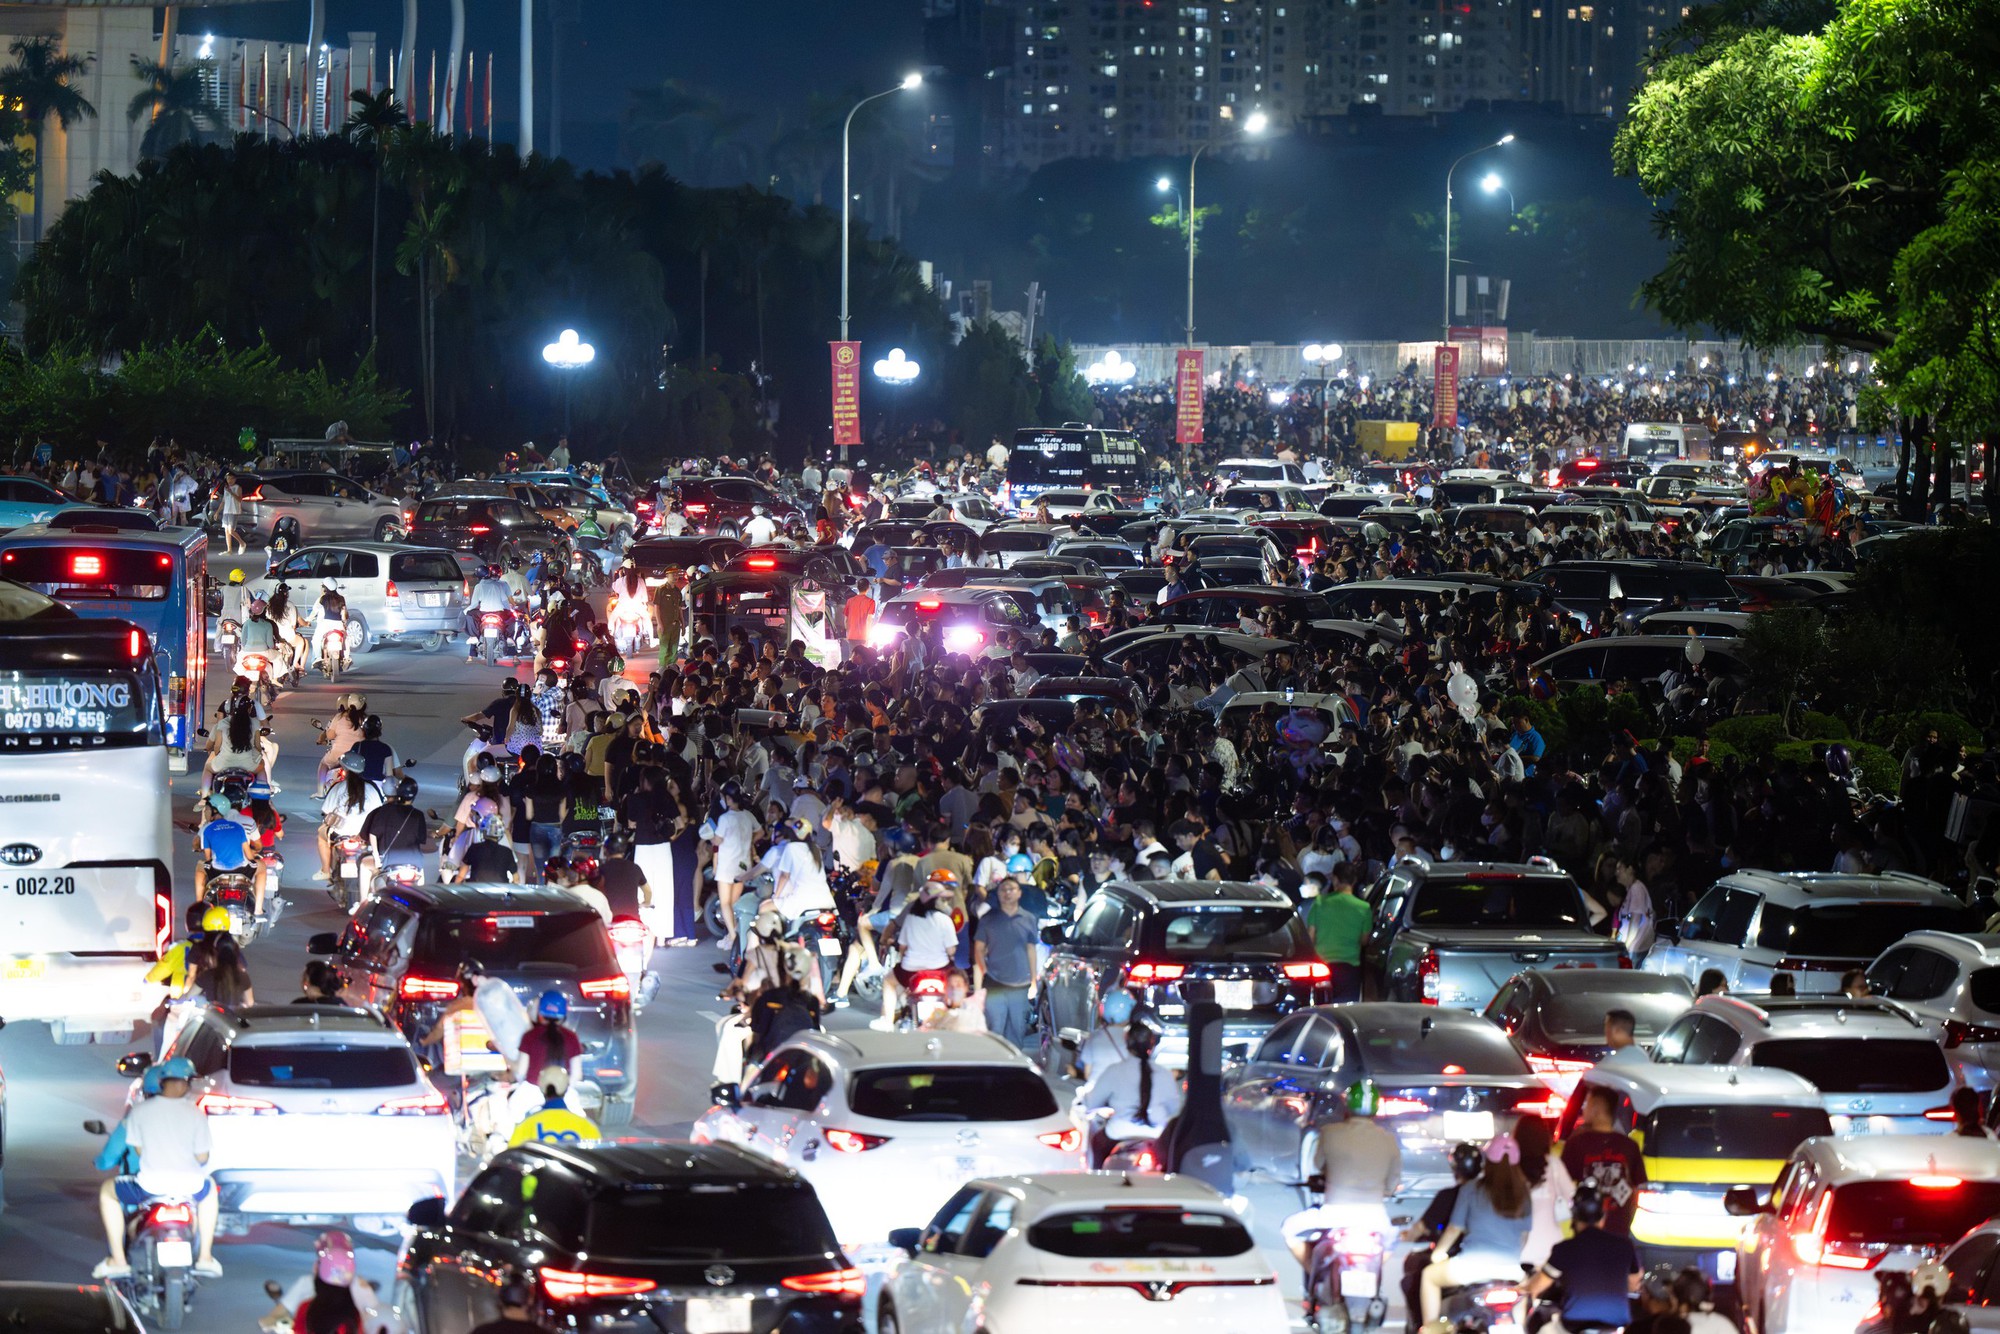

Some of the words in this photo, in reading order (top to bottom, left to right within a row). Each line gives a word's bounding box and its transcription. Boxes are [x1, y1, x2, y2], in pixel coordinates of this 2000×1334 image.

[1039, 443, 1059, 451] 1900
[1060, 443, 1082, 451] 3189
[25, 681, 130, 709] HƯƠNG
[5, 711, 42, 729] 0979
[45, 711, 74, 728] 945
[4, 847, 36, 863] KIA
[16, 876, 75, 896] 002.20
